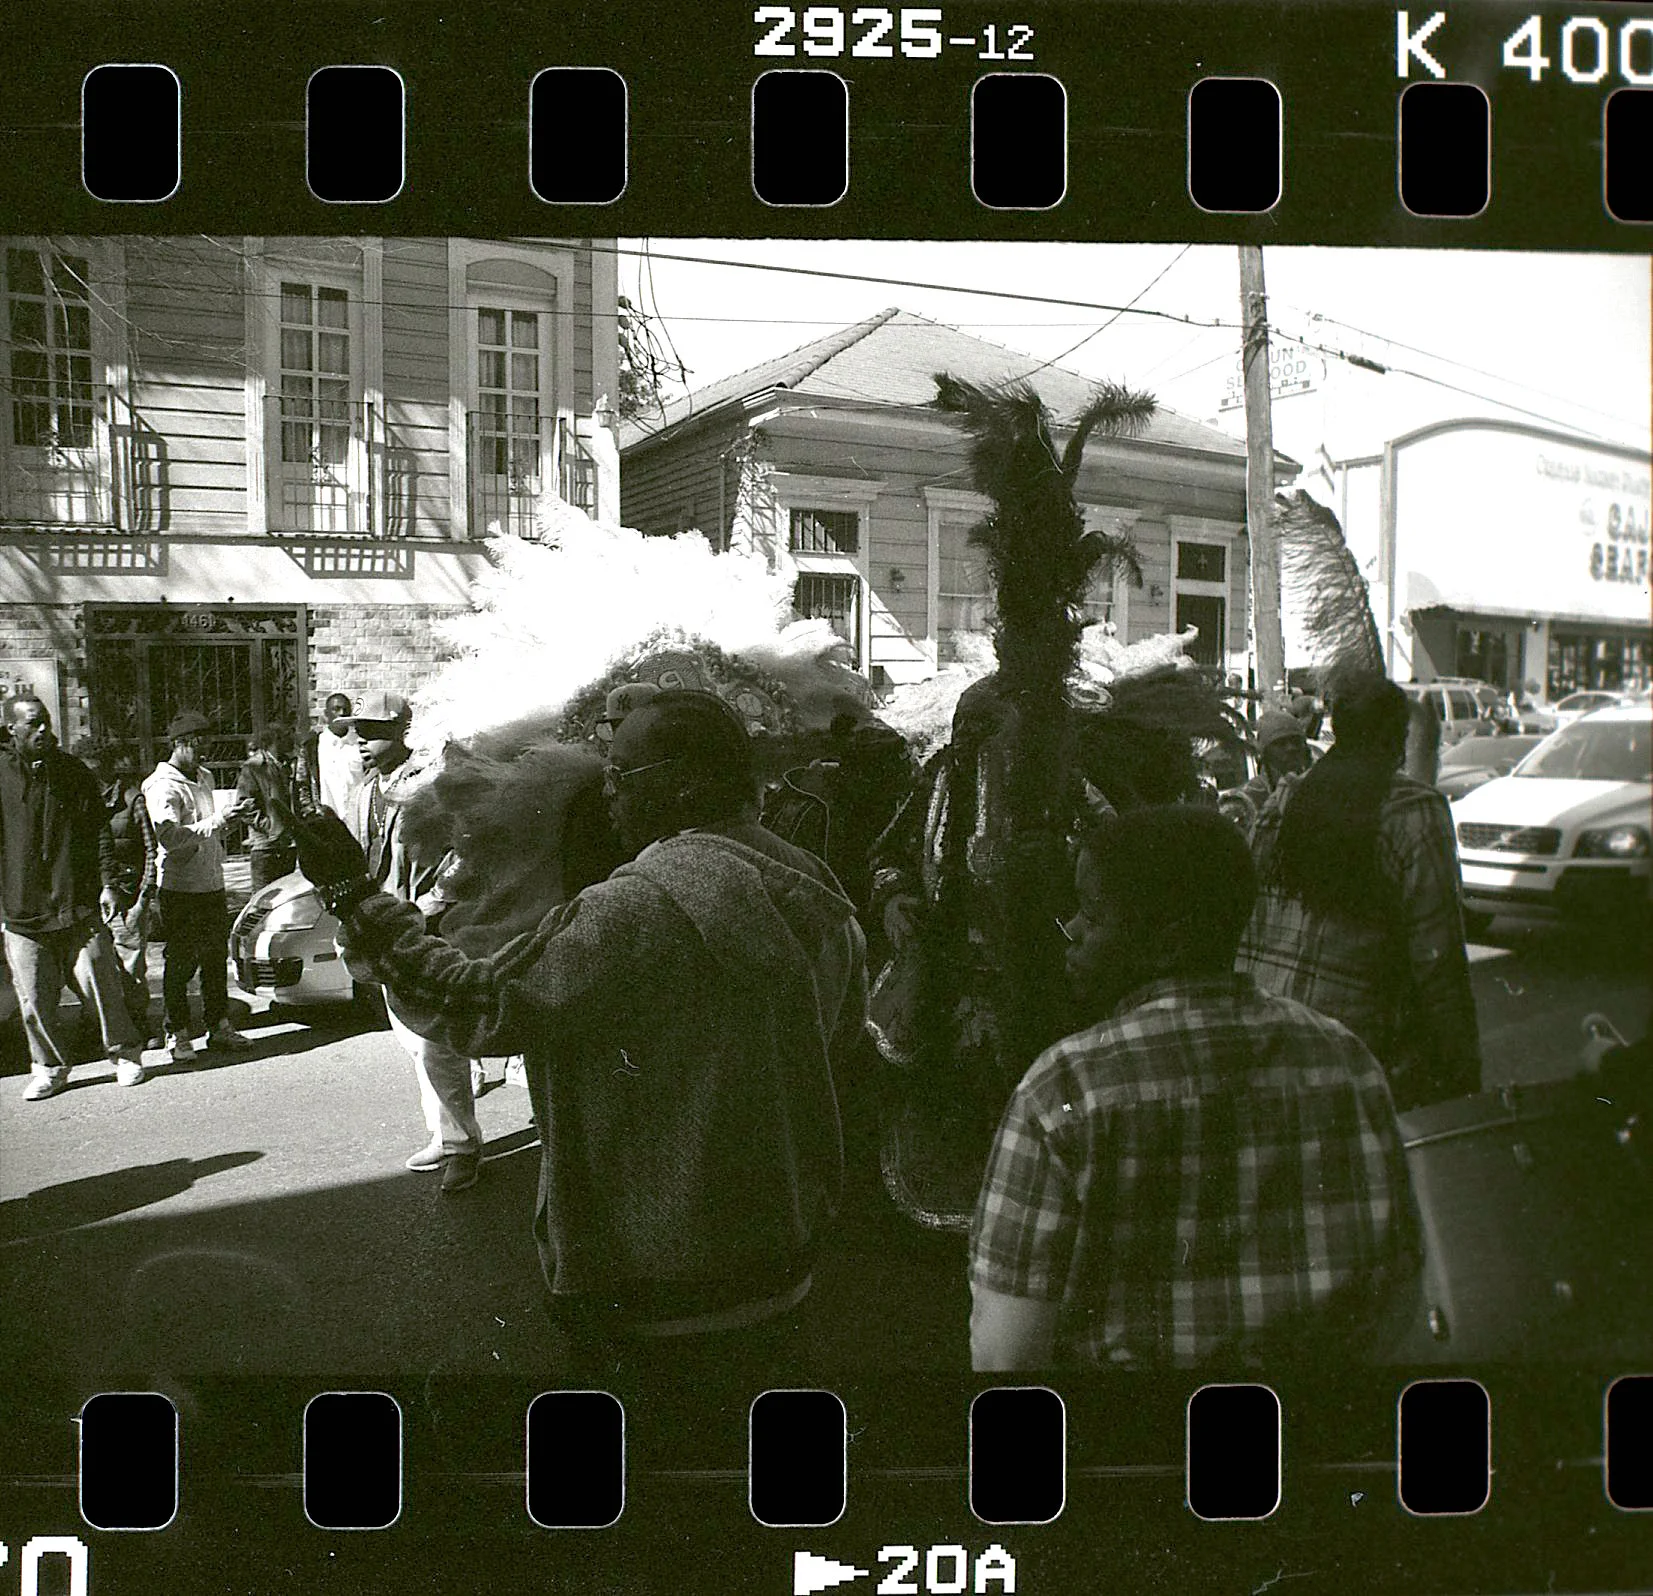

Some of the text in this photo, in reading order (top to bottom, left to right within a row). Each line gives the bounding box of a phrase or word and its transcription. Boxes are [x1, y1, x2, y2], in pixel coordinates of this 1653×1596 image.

[1397, 10, 1653, 85] K 400
[877, 1544, 1016, 1595] 20A
